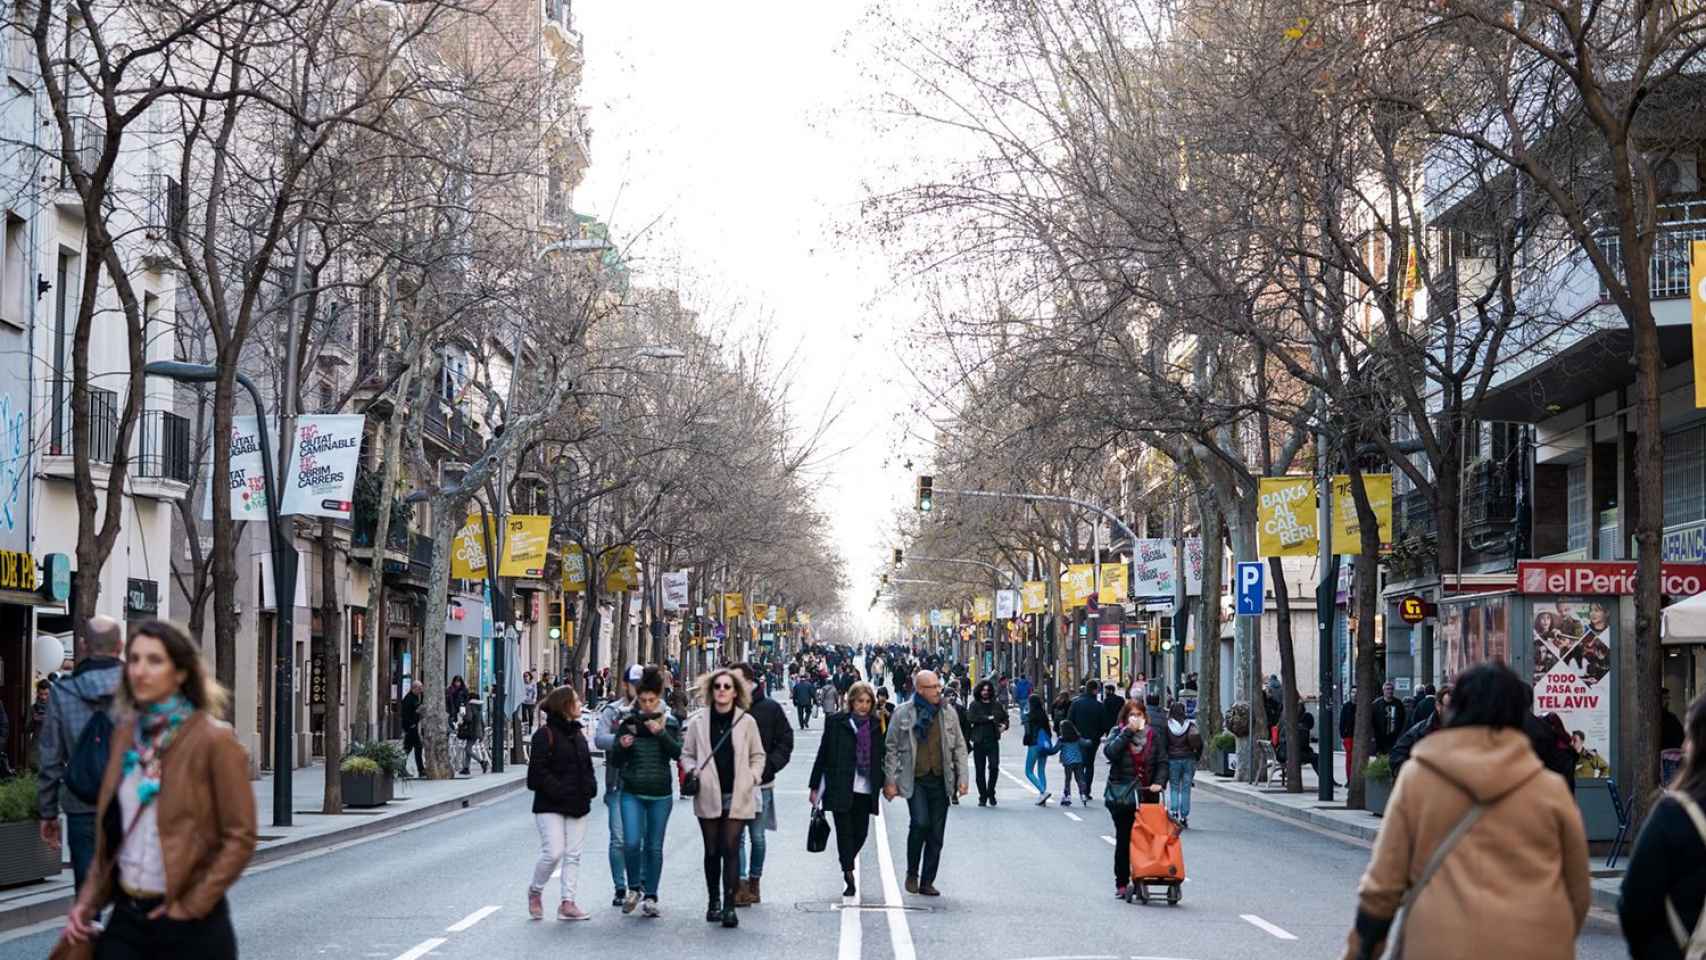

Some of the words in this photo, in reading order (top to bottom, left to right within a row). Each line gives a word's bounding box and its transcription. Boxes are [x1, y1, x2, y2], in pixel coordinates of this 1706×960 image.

[300, 433, 333, 449] CIUTAT
[300, 437, 356, 457] CAMINABLE
[298, 465, 331, 481] OBRIM
[298, 471, 344, 488] CARRERS
[1261, 483, 1308, 508] BAIXA
[1274, 501, 1291, 520] AL
[1264, 511, 1297, 535] CAR
[1280, 524, 1316, 546] RER!
[456, 544, 481, 560] CAR
[0, 551, 17, 587] DE
[1243, 566, 1259, 594] P
[1548, 568, 1571, 593] el
[1575, 568, 1700, 597] Perióico
[1547, 674, 1576, 684] TODO
[1546, 684, 1571, 694] PASA
[1574, 686, 1586, 694] en
[1537, 696, 1560, 709] TEL
[1564, 696, 1599, 709] AVIV
